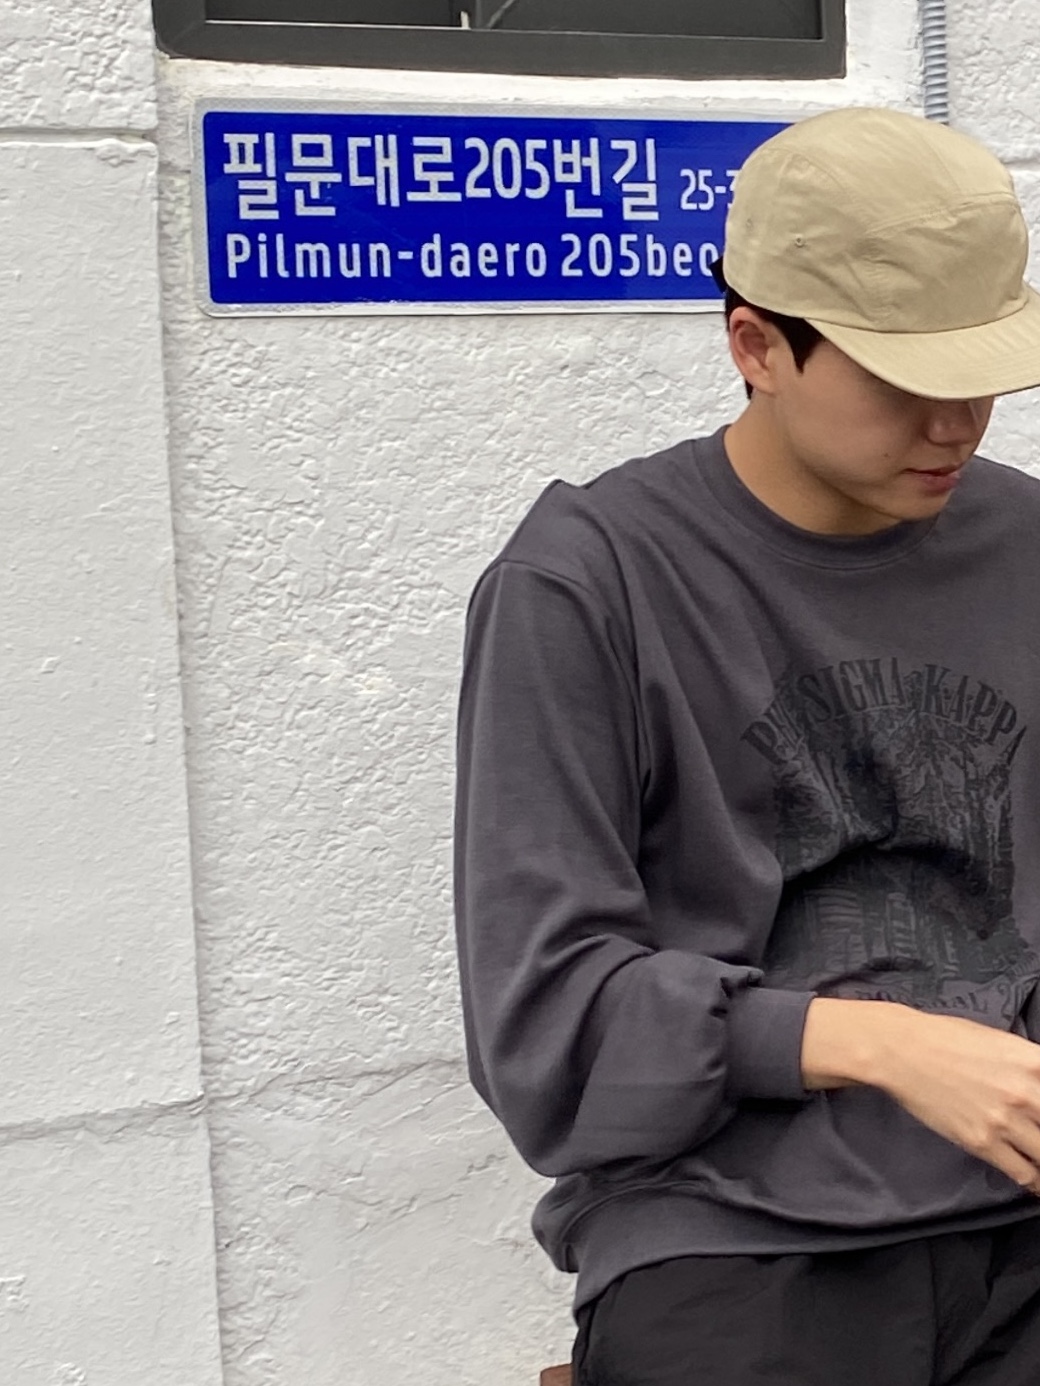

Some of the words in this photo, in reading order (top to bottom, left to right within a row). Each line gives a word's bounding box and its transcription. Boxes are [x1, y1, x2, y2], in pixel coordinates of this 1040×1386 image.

[222, 131, 660, 221] 필문대로205번길
[226, 233, 548, 279] Pilmun-daero
[797, 656, 907, 723] SIGMA
[920, 663, 1028, 767] KAPPA
